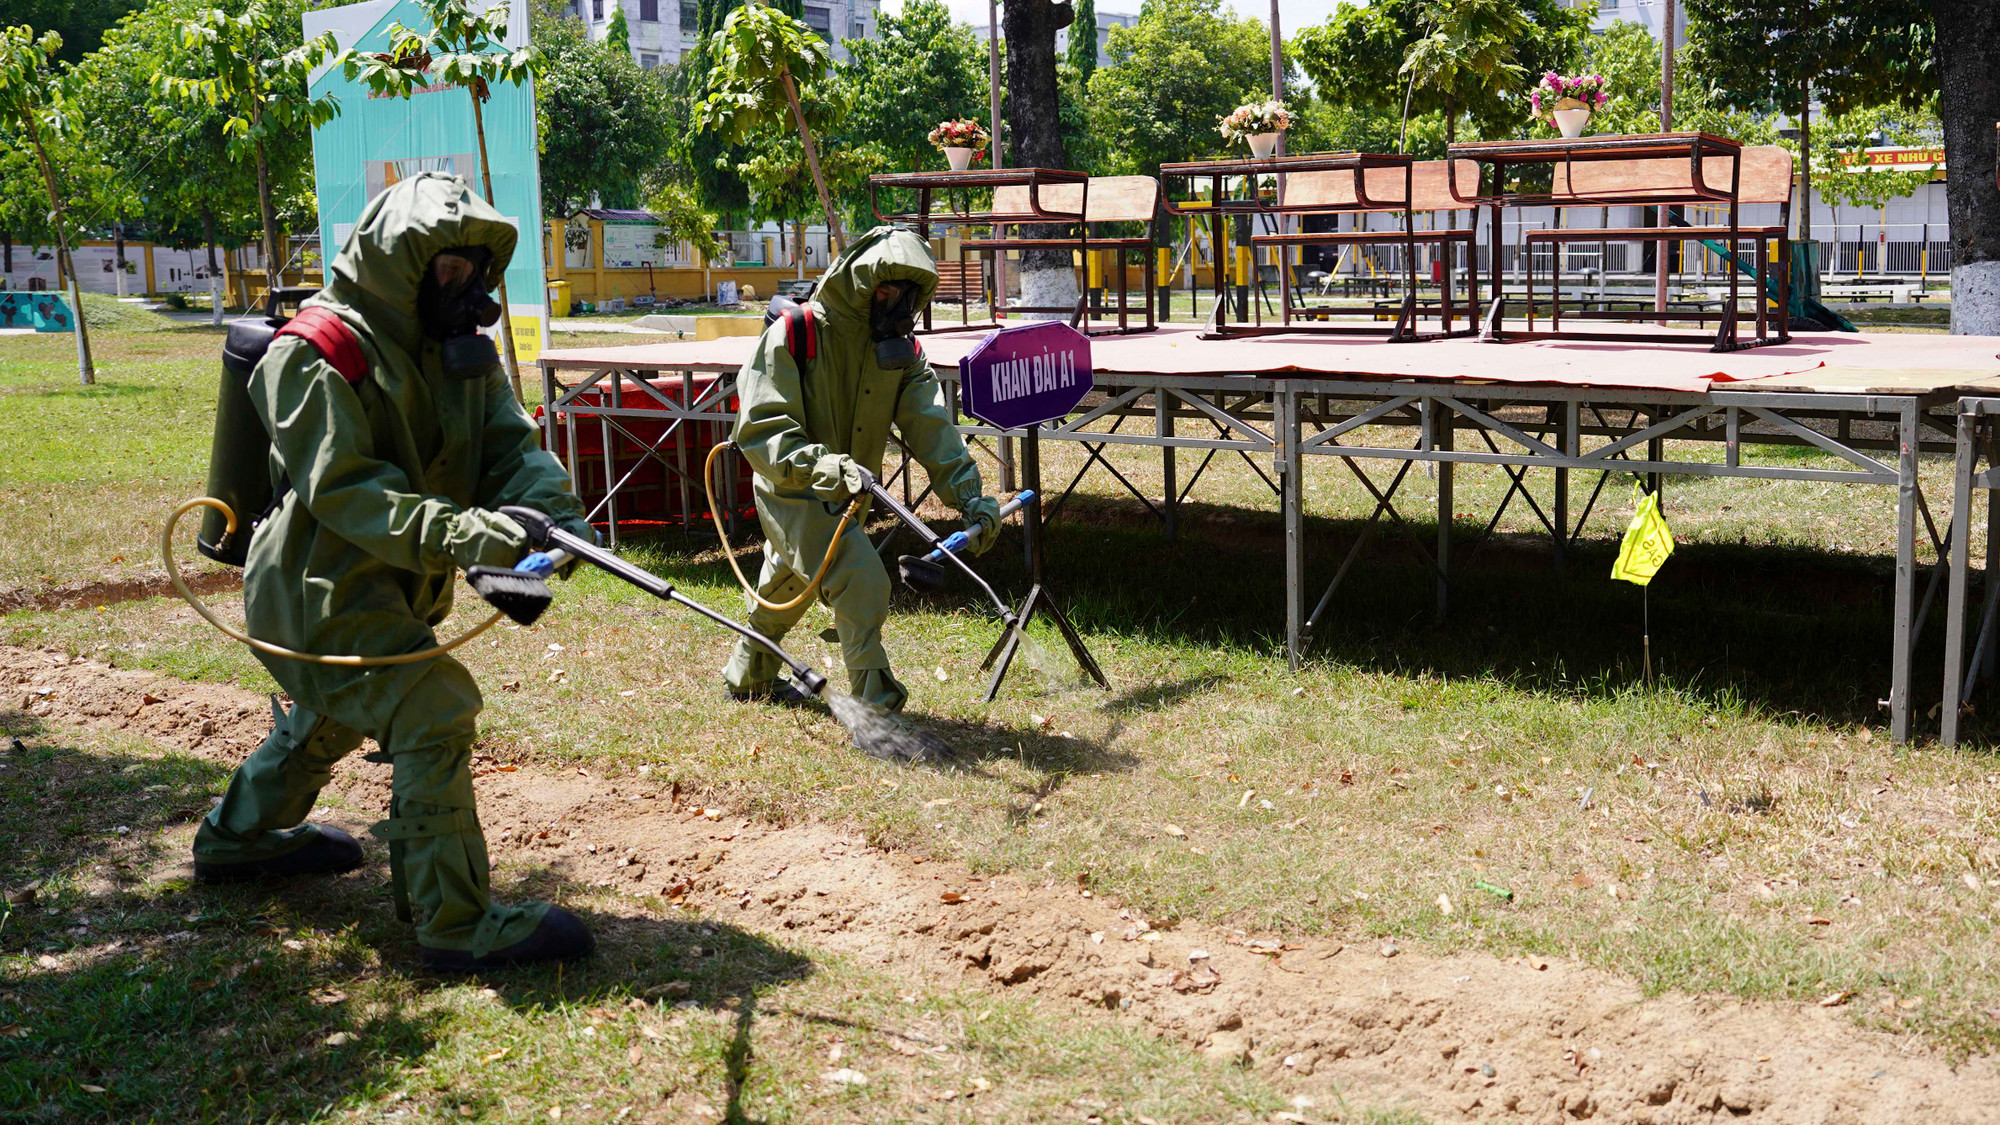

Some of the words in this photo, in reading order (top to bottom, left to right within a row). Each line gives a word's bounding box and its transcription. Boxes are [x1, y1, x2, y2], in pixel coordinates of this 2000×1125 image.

[1875, 153, 1893, 163] XE
[990, 351, 1031, 403] KHÁN
[1033, 345, 1057, 394] ĐÀI
[1060, 349, 1076, 389] A1
